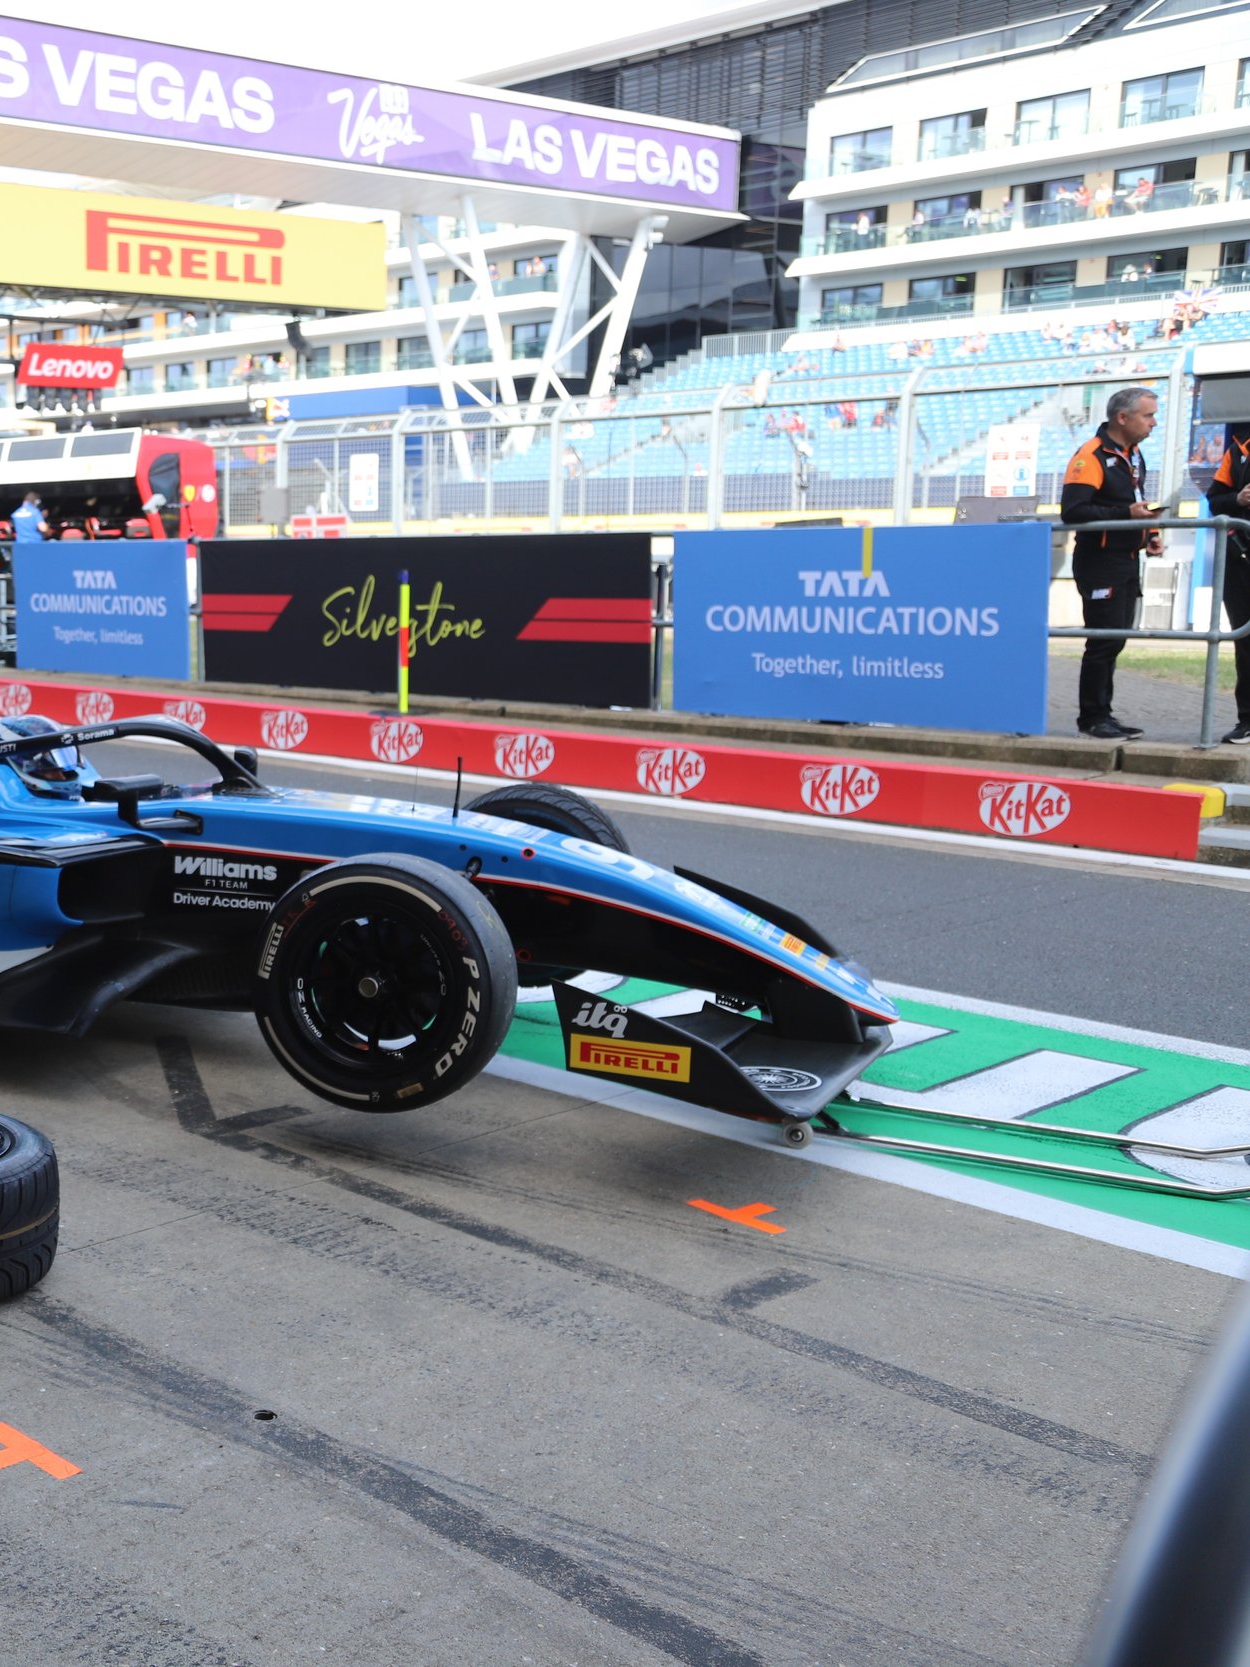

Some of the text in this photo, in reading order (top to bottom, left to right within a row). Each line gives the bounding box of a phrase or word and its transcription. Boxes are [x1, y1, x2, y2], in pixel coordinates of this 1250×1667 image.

[42, 42, 276, 134] VEGAS
[327, 87, 425, 164] Vegas
[470, 111, 720, 195] LAS VEGAS
[86, 209, 286, 286] PIRELLI
[27, 352, 115, 380] Lenovo
[72, 570, 118, 590] TATA
[798, 570, 891, 598] TATA
[30, 593, 168, 618] COMMUNICATIONS
[321, 574, 486, 659] Silvestone
[705, 605, 1000, 637] COMMUNICATIONS
[52, 626, 144, 646] Together, limitless
[751, 652, 945, 680] Together, limitless
[77, 728, 115, 742] Sorama
[267, 712, 306, 749] KitKat
[377, 723, 421, 762] KitKat
[501, 734, 551, 778] KitKat
[646, 748, 702, 794] KitKat
[810, 766, 876, 813] KitKat
[989, 783, 1068, 834] KitKat
[174, 855, 278, 881] Williams
[205, 878, 248, 890] F1 TEAM
[173, 892, 276, 912] Driver Academy
[257, 922, 285, 980] PIRELLI
[301, 1006, 323, 1039] RACING
[435, 956, 481, 1079] P ZERO
[579, 1041, 681, 1075] PIRELLI
